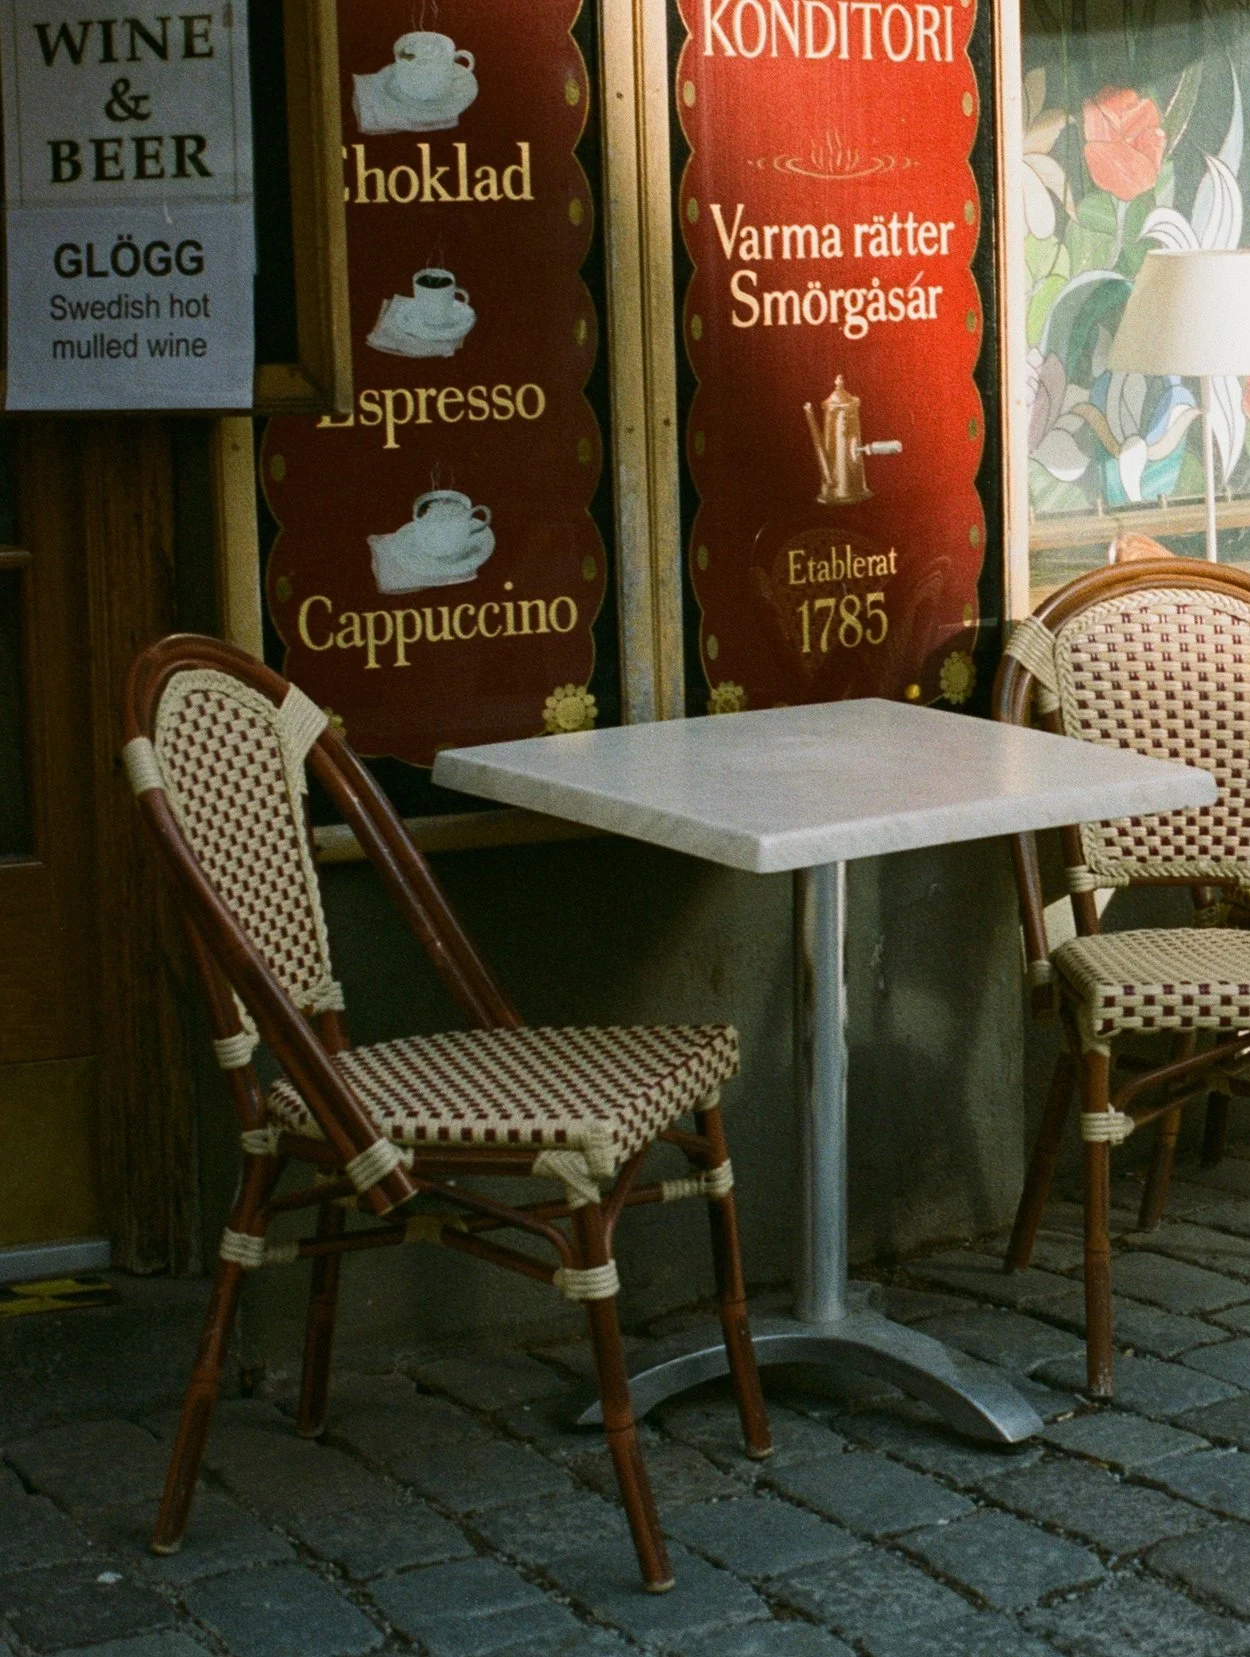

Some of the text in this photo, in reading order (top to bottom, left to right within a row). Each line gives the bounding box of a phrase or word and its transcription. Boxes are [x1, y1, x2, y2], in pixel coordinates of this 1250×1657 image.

[33, 14, 214, 67] WINE
[703, 0, 953, 62] KONDITORI
[104, 77, 151, 122] &
[47, 134, 213, 183] BEER
[340, 142, 534, 203] hoklad
[53, 234, 204, 279] GLÖGG
[710, 203, 955, 261] Varma rätter
[50, 293, 211, 321] Swedish hot
[52, 332, 208, 360] mulled wine
[788, 545, 898, 586] Etablerat
[298, 580, 578, 669] Cappuccino
[798, 592, 888, 654] 1785
